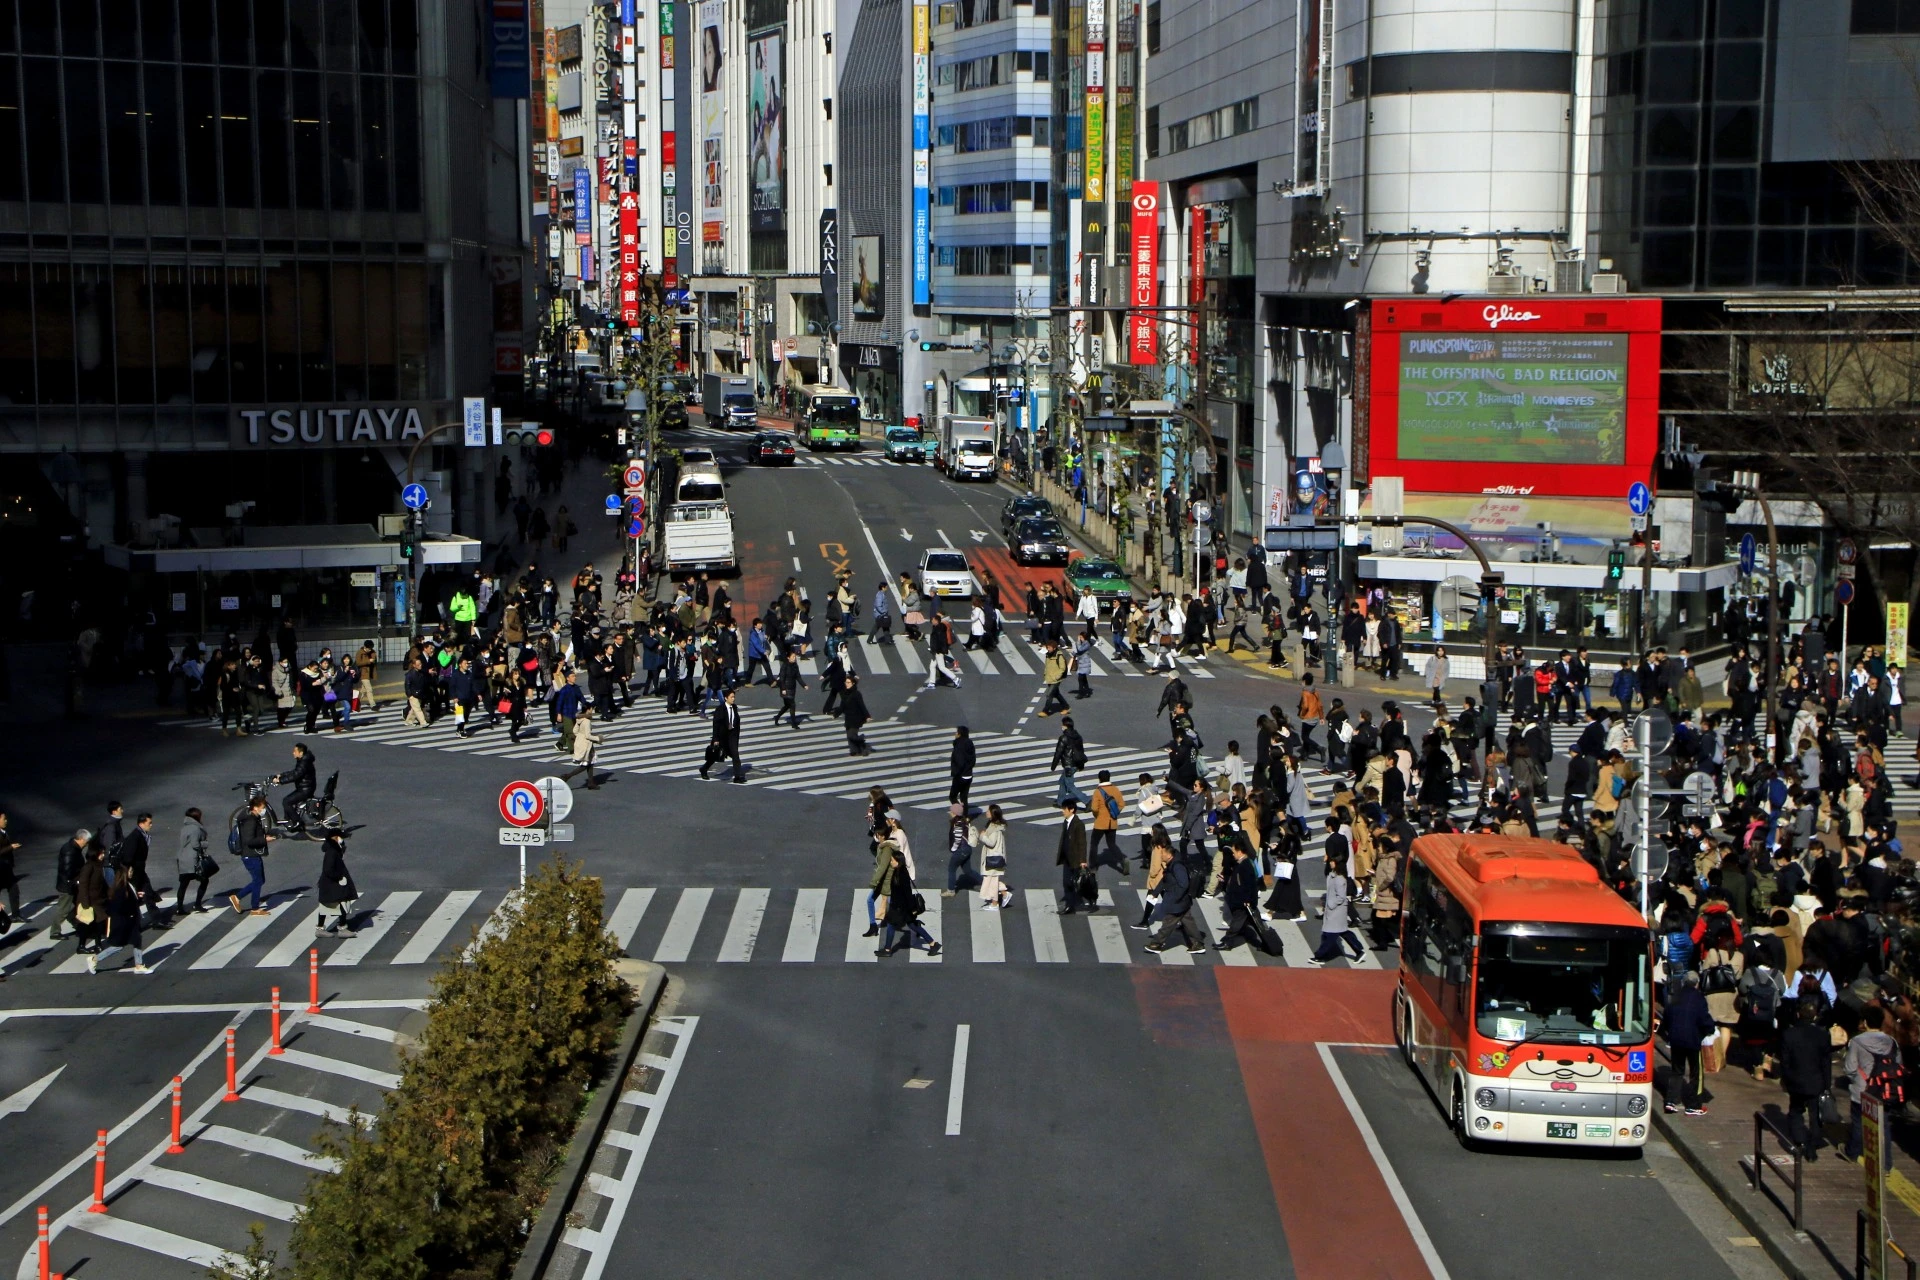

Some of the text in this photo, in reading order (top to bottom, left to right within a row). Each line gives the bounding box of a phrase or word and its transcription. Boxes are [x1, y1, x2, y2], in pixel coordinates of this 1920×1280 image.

[594, 5, 609, 101] KARAOKE
[916, 57, 926, 99] パーソナル
[606, 119, 618, 185] カラオケ
[576, 179, 586, 217] 渋谷整形
[754, 191, 780, 211] SCANDAL
[823, 220, 836, 275] ZARA
[917, 209, 926, 281] 三井住友信託銀行
[624, 234, 637, 321] 東日本銀行
[1089, 258, 1097, 304] McDonald's
[859, 346, 881, 366] ZARA
[1093, 339, 1101, 369] 丸大ビル
[1404, 367, 1617, 381] THE OFFSPRING BAD RELIGION
[1426, 391, 1469, 406] NOFX
[1532, 396, 1595, 406] MONOEYES
[241, 408, 424, 443] TSUTAYA
[473, 401, 482, 443] 渋谷駅前
[503, 833, 541, 843] ここから
[1625, 1073, 1648, 1082] D066
